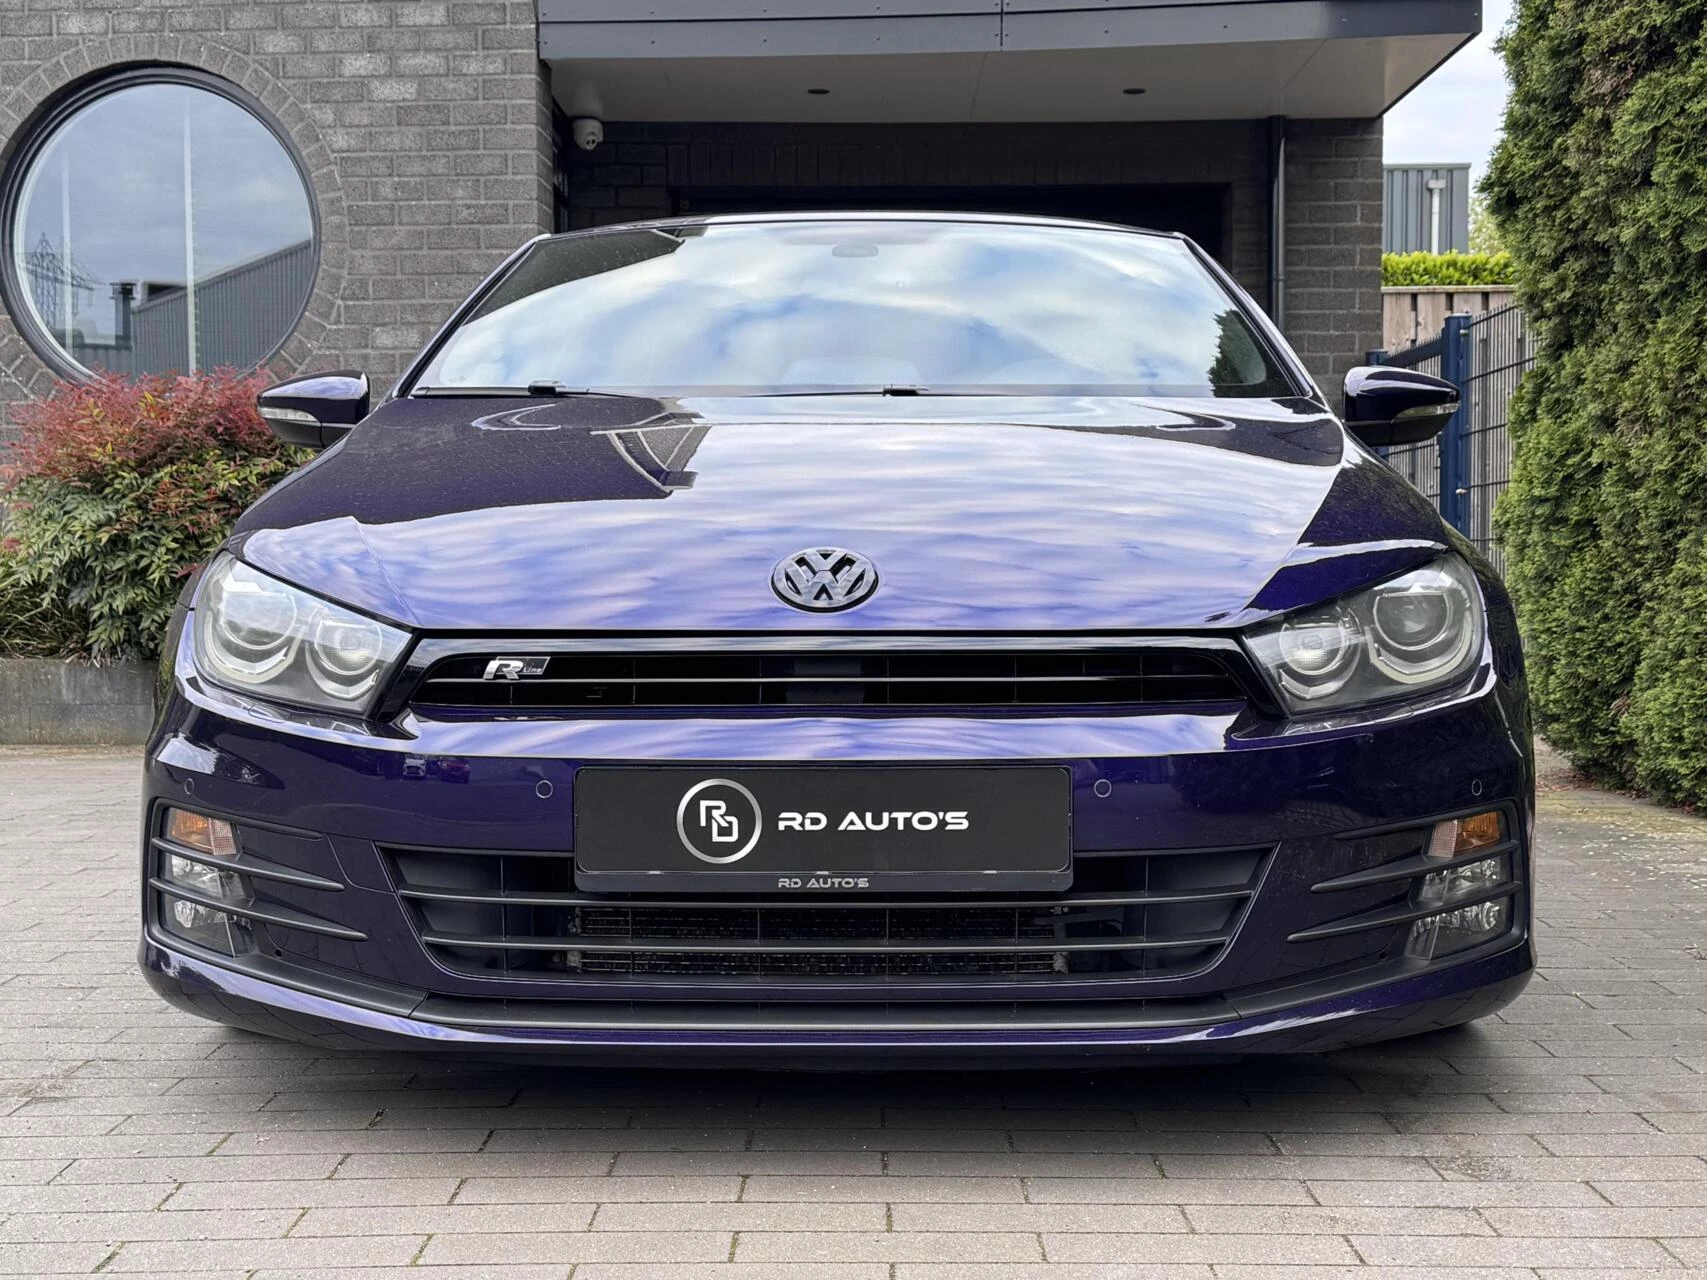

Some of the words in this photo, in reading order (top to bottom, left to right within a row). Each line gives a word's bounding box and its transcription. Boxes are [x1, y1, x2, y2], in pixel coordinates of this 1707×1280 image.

[483, 660, 524, 680] R
[778, 811, 828, 831] RD
[837, 811, 970, 831] AUTO'S
[778, 878, 802, 888] RD
[806, 877, 870, 888] AUTO'S
